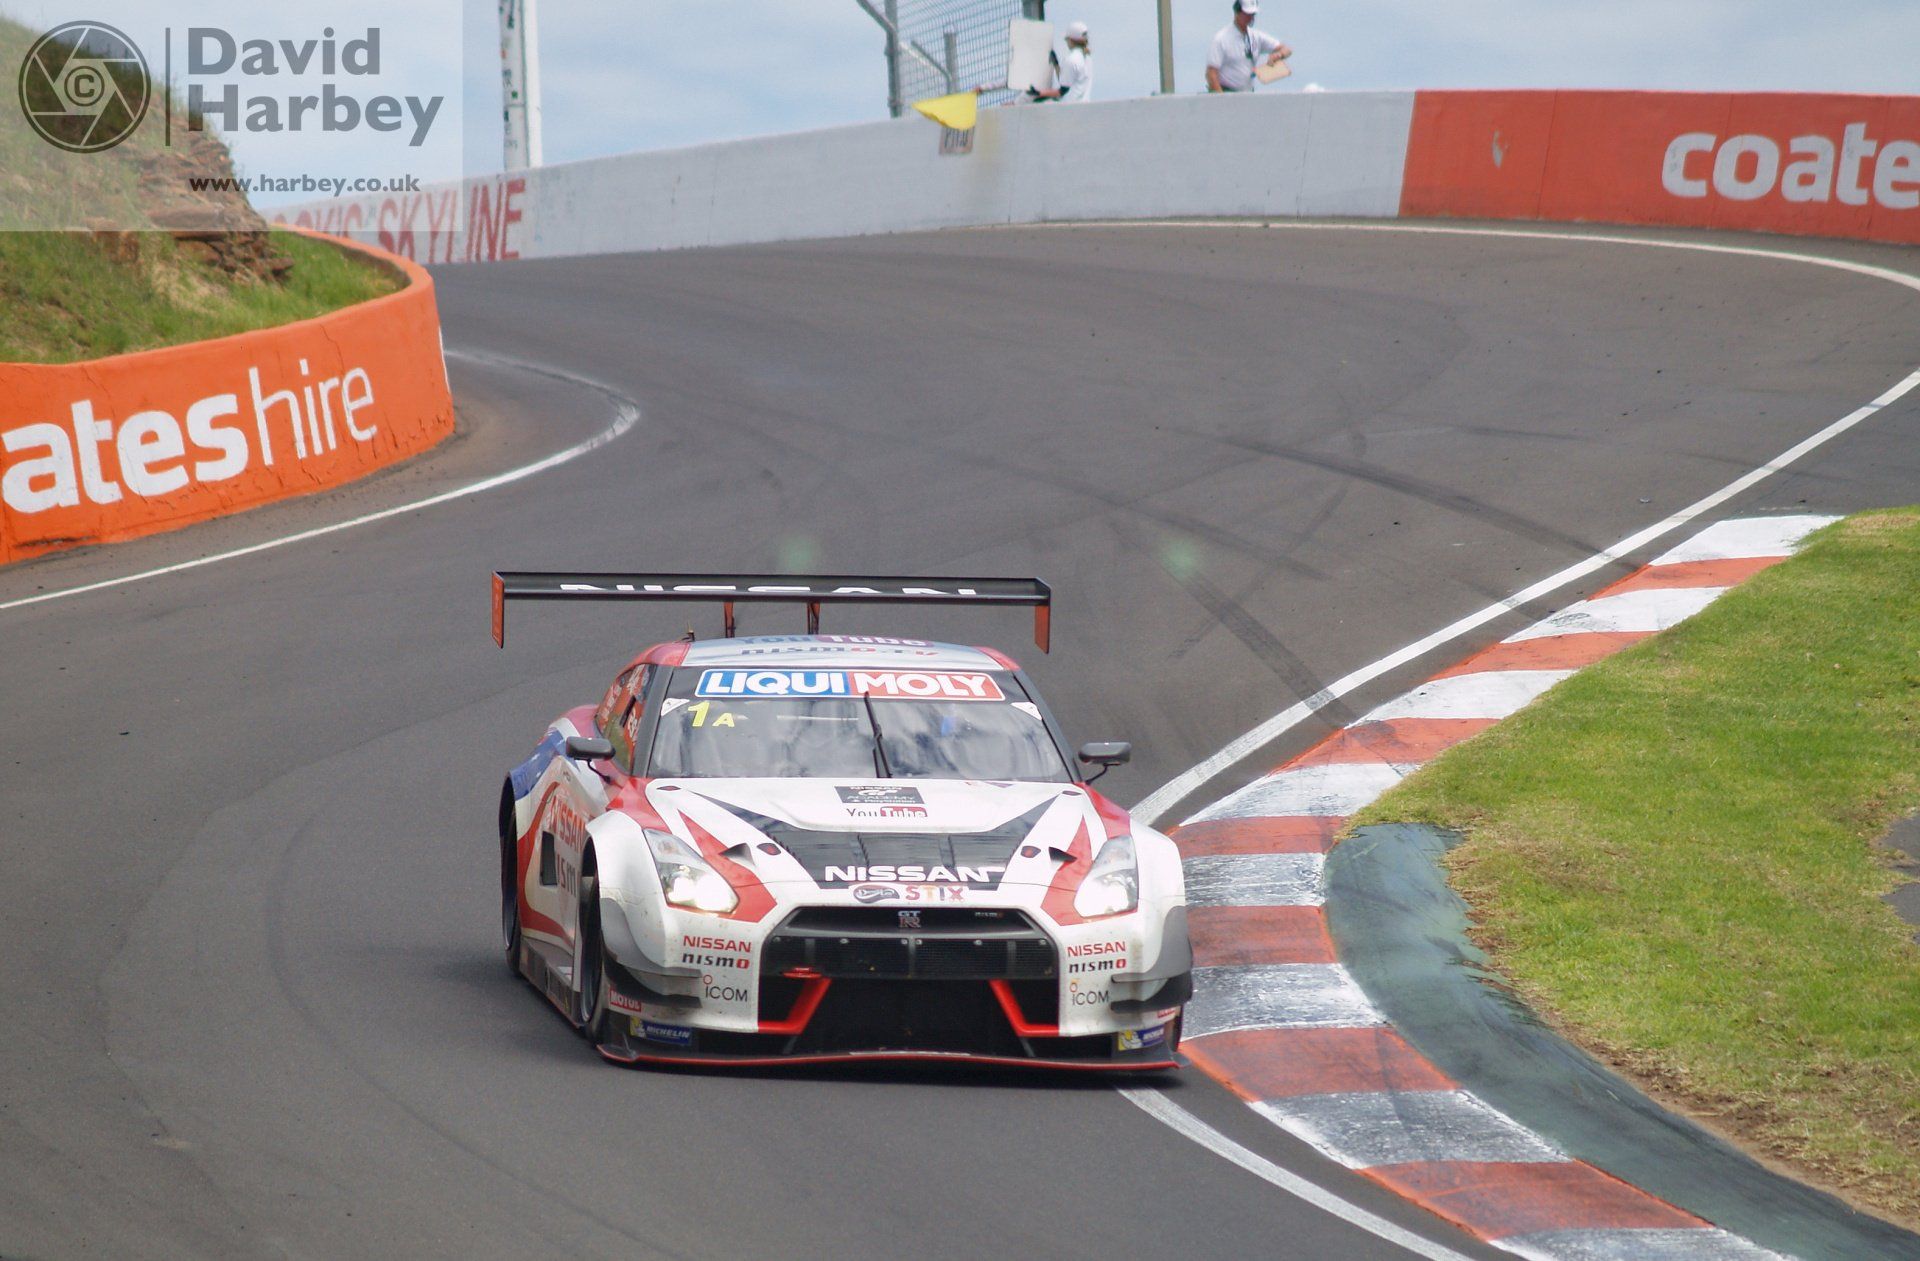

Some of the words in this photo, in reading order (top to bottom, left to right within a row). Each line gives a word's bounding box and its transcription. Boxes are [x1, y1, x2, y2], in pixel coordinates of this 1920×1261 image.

[248, 358, 378, 466] hire
[704, 672, 846, 695] LIQUI
[853, 673, 987, 696] MOLY
[825, 865, 1006, 882] NISSAN
[905, 885, 964, 902] STIX
[683, 935, 751, 953] NISSAN
[1067, 941, 1126, 957] NISSAN
[682, 953, 750, 970] nismo
[1069, 958, 1127, 973] nismo
[646, 1025, 690, 1039] MICHELIN
